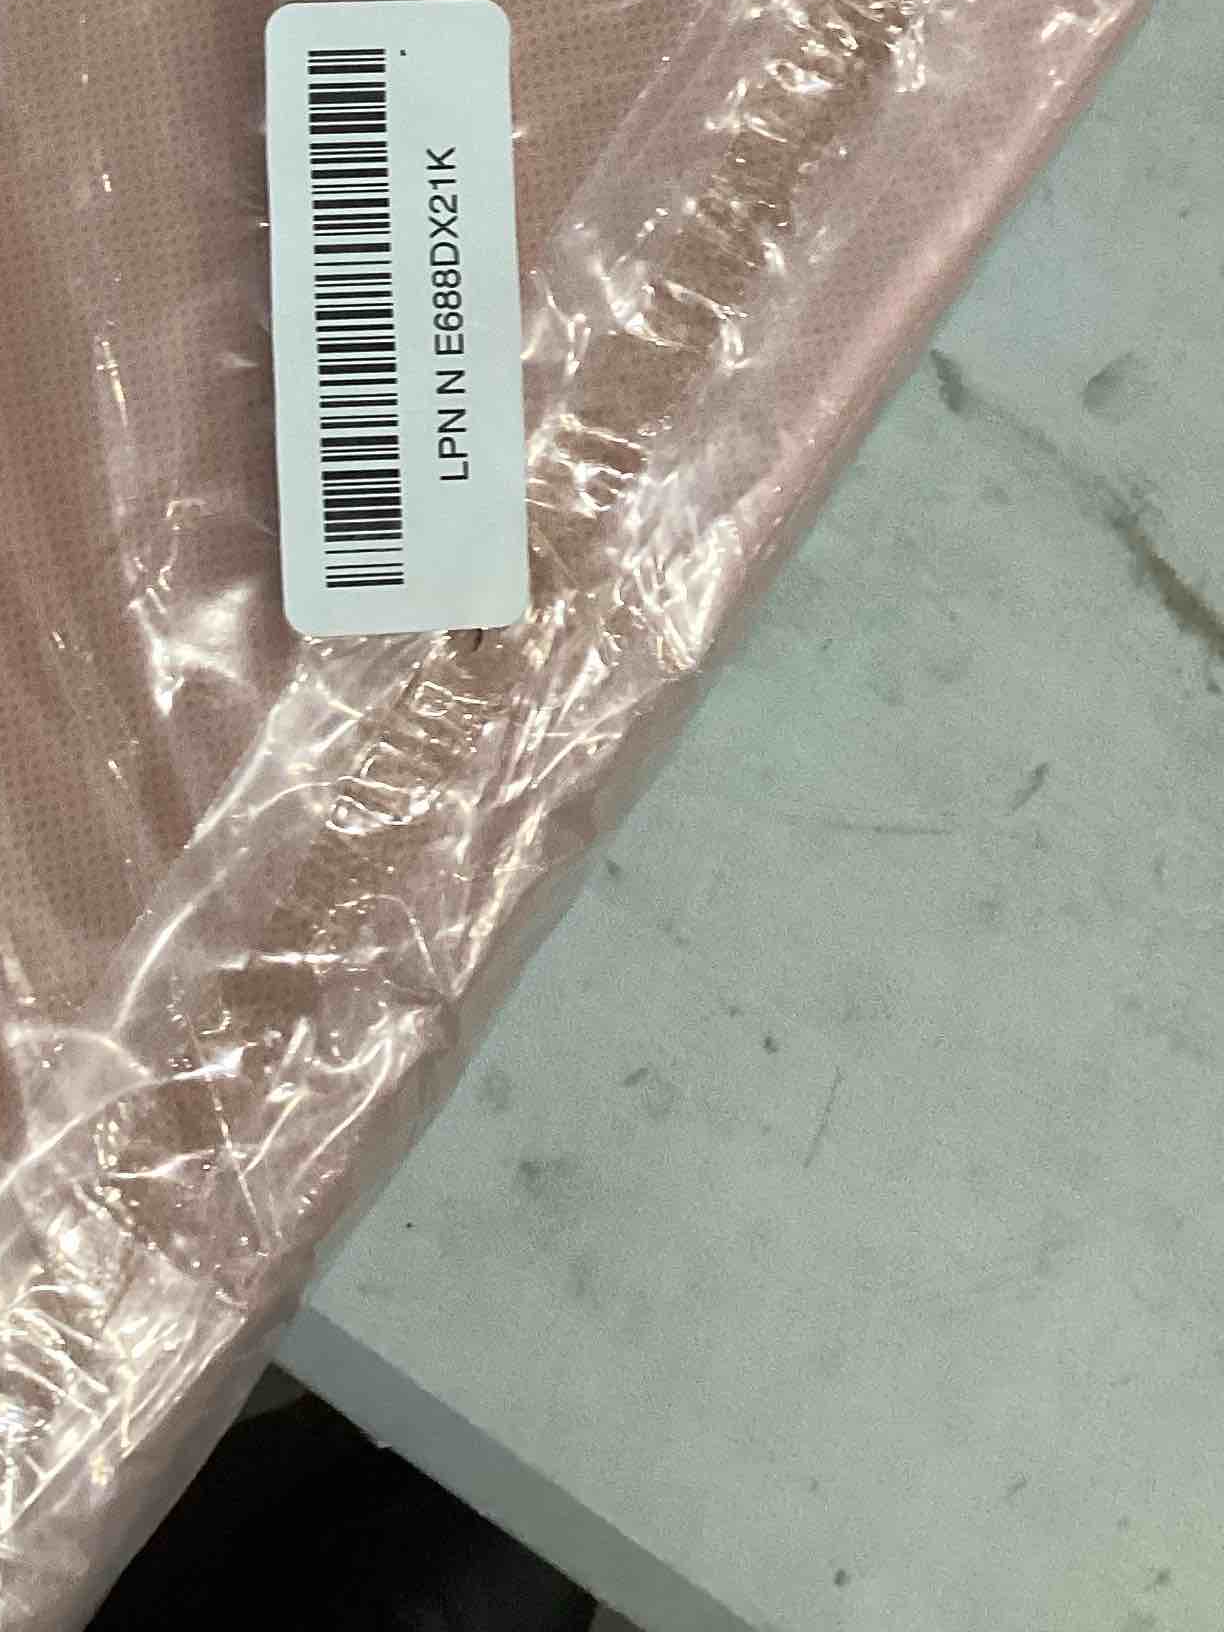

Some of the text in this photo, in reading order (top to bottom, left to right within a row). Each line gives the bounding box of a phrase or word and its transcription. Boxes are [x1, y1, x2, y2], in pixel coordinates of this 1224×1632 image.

[427, 147, 468, 481] LPN N E688DX21K
